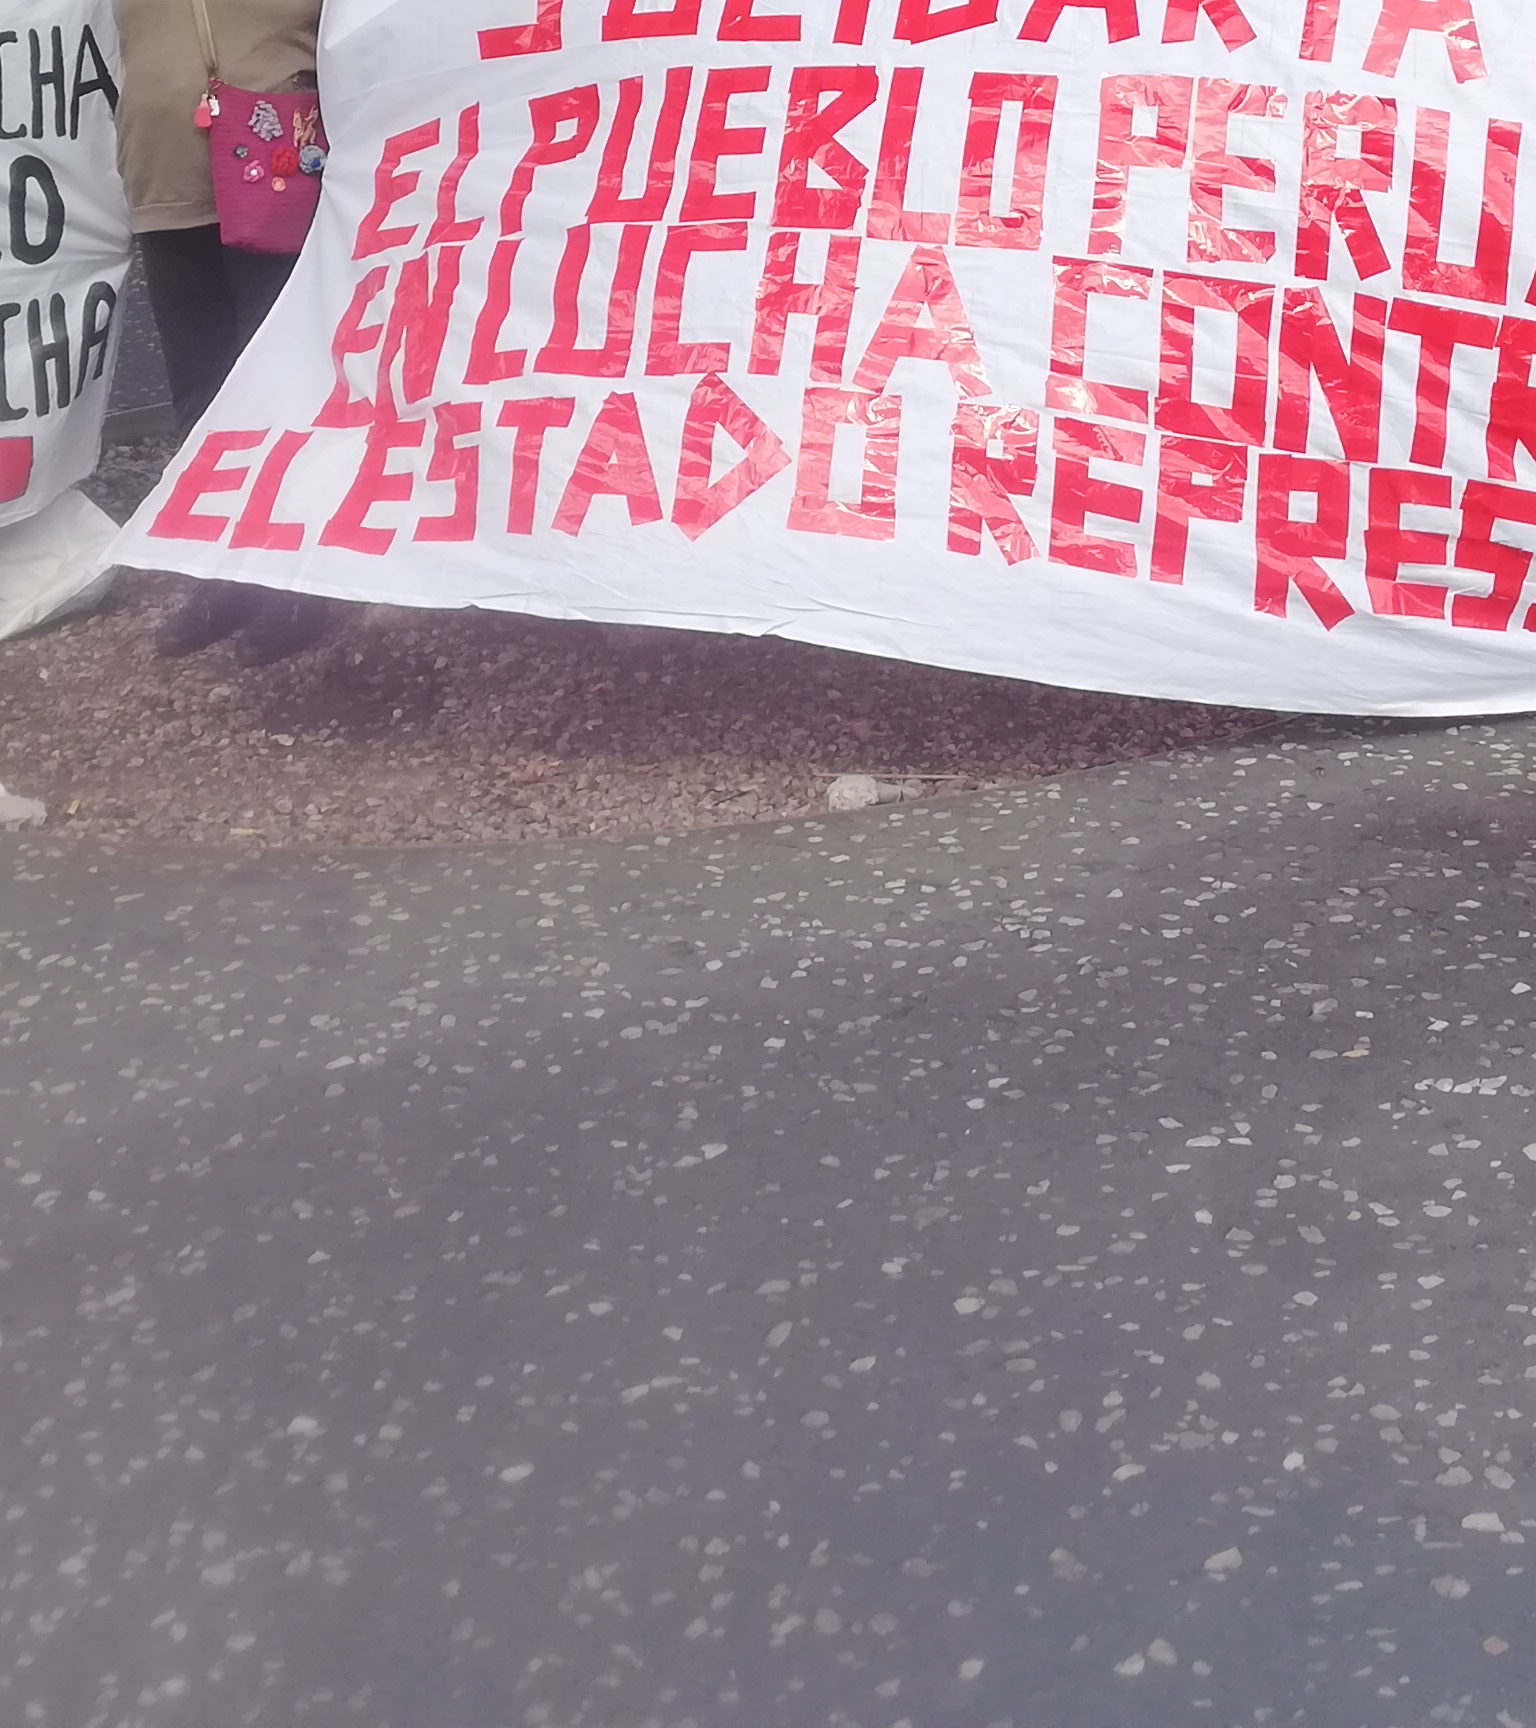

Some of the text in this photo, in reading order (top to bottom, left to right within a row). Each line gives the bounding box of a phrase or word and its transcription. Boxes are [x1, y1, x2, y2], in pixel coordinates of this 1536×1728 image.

[352, 101, 483, 261] EL
[500, 65, 1059, 249] PUEBLO
[313, 241, 463, 429] EN
[462, 222, 993, 400] LUCHA
[147, 428, 305, 553] EL
[319, 371, 902, 558] ESTADO
